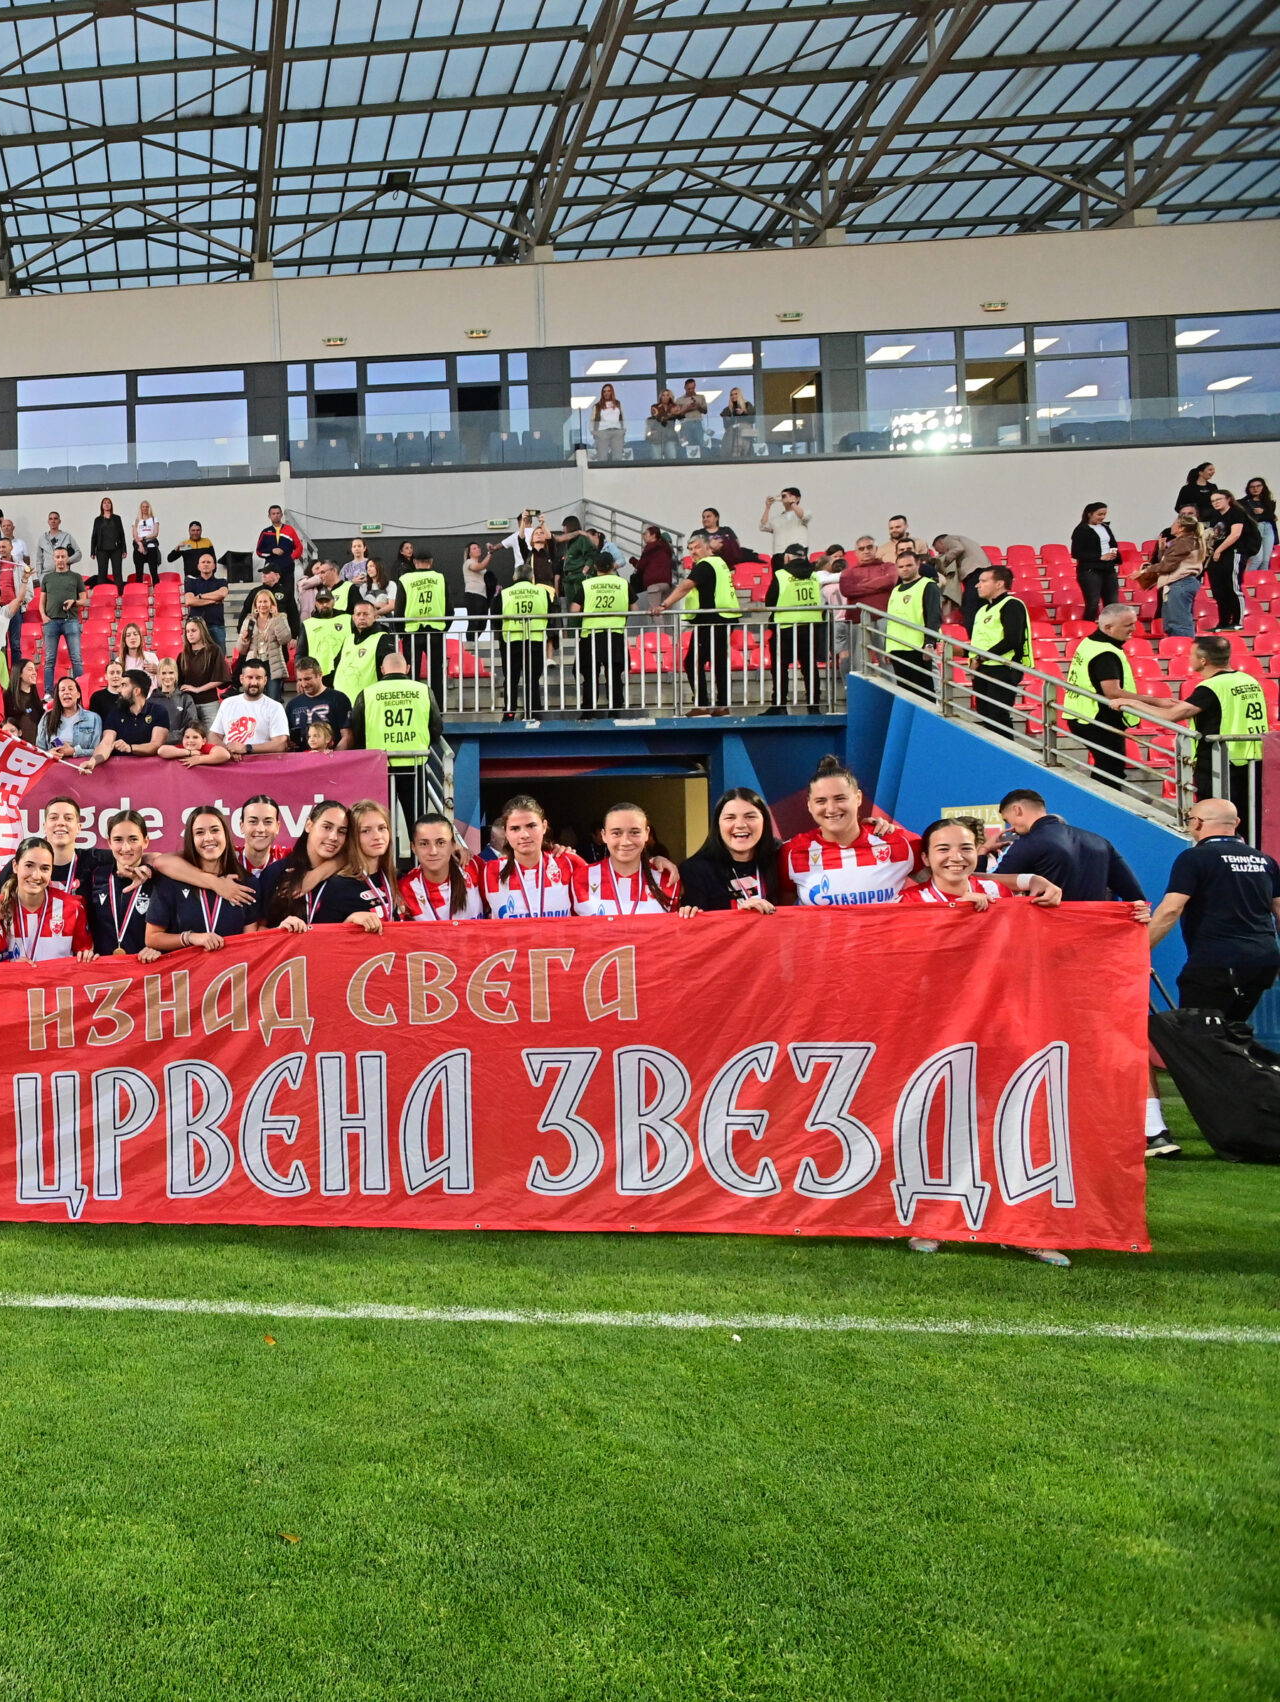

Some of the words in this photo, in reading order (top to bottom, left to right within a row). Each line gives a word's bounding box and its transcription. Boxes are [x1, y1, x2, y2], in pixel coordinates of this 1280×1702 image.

[515, 600, 533, 614] 159
[595, 595, 615, 609] 232
[376, 691, 420, 701] ОБЕЗБЕЂЕЊЕ
[384, 708, 413, 727] 847
[384, 731, 416, 743] РЕДАР
[834, 887, 895, 905] ГАЗПРОМ
